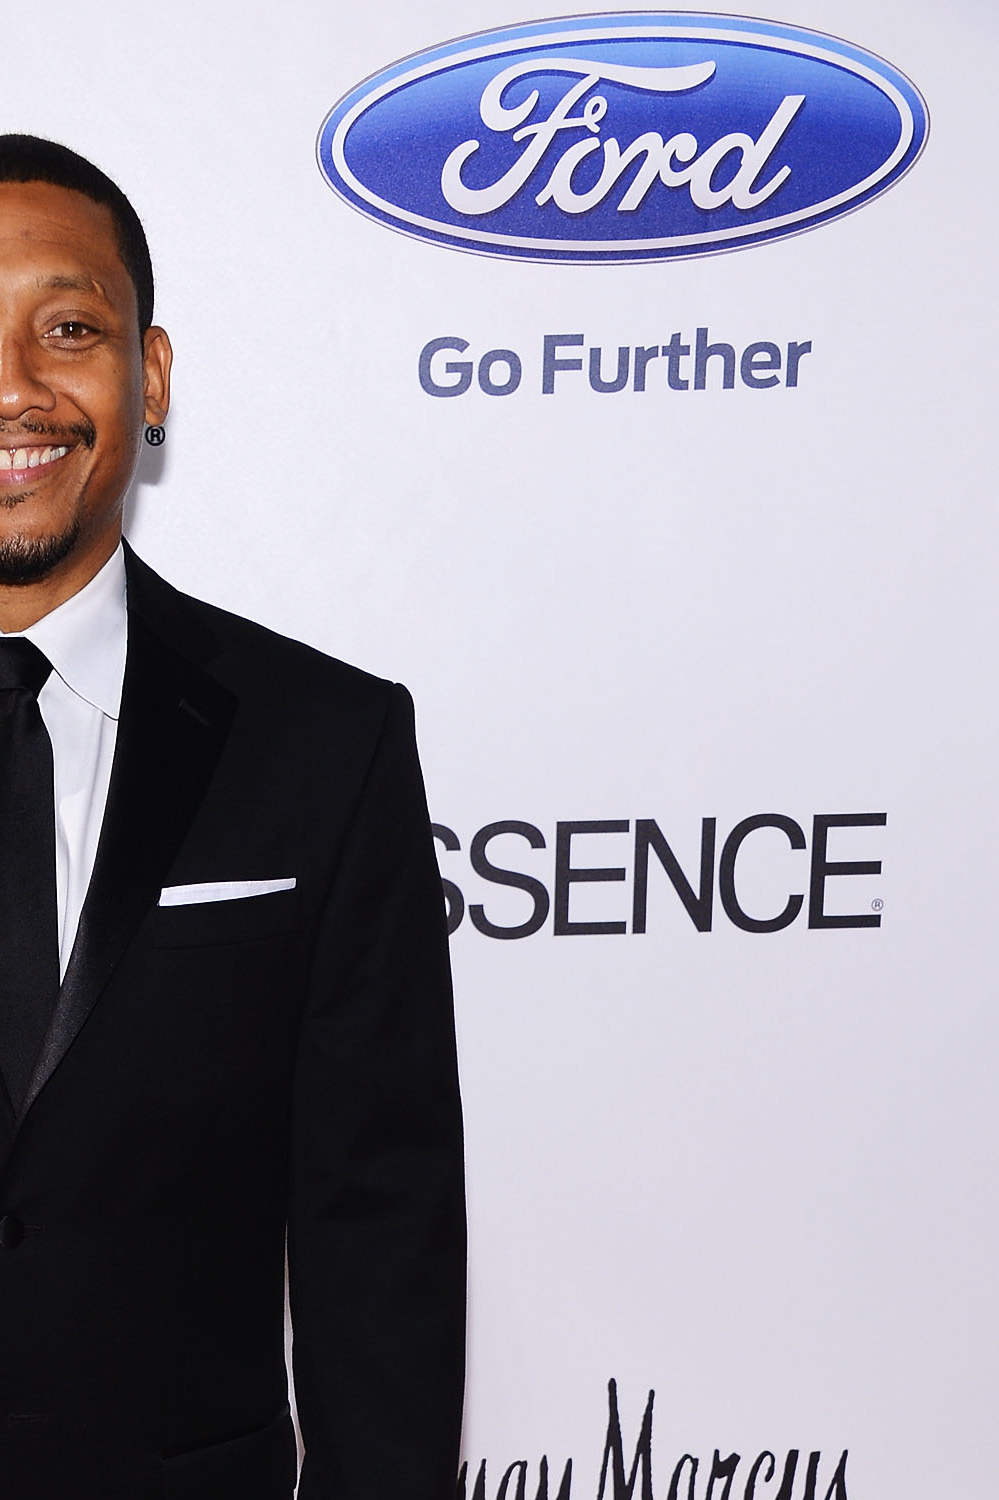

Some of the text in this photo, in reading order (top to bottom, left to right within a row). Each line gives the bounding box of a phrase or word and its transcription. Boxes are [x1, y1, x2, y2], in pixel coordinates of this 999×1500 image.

[442, 57, 806, 216] Ford
[418, 328, 813, 398] Go Further
